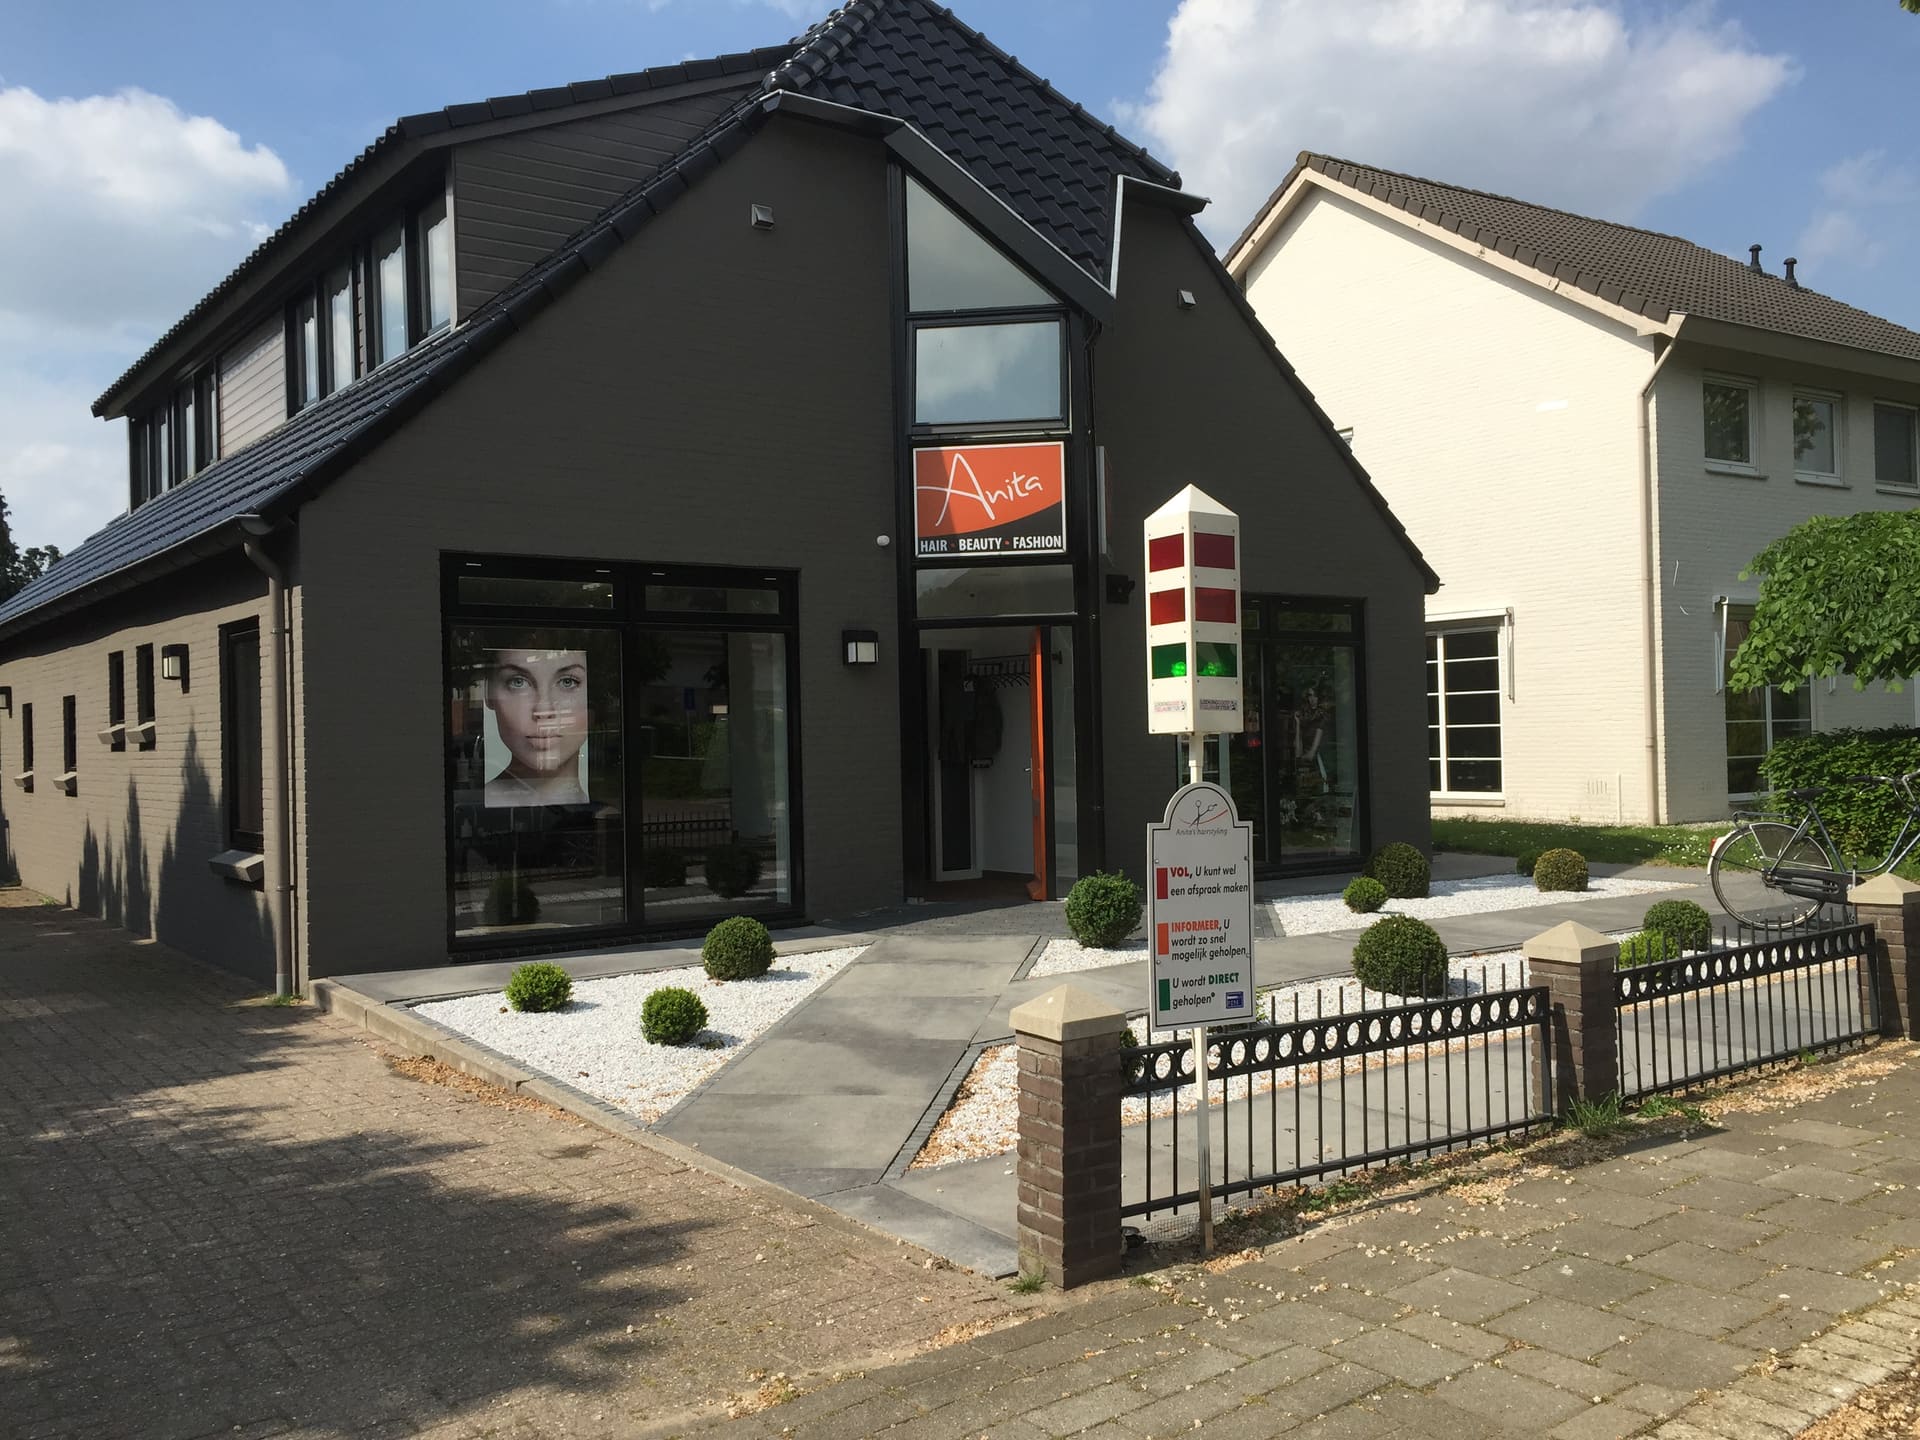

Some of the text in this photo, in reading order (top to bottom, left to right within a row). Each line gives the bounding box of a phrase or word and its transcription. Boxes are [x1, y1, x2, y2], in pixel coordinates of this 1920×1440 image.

[916, 453, 1043, 527] Anita
[920, 535, 1062, 552] HAIR BEAUTY FASHION
[1170, 864, 1236, 879] VOL, U kunt wel
[1170, 882, 1248, 897] een afspraak maken
[1171, 919, 1230, 932] INFORMEER, U
[1171, 932, 1227, 947] wordt zo snel
[1171, 945, 1246, 962] mogelijk geholpen
[1172, 972, 1240, 988] U wordt DIRECT
